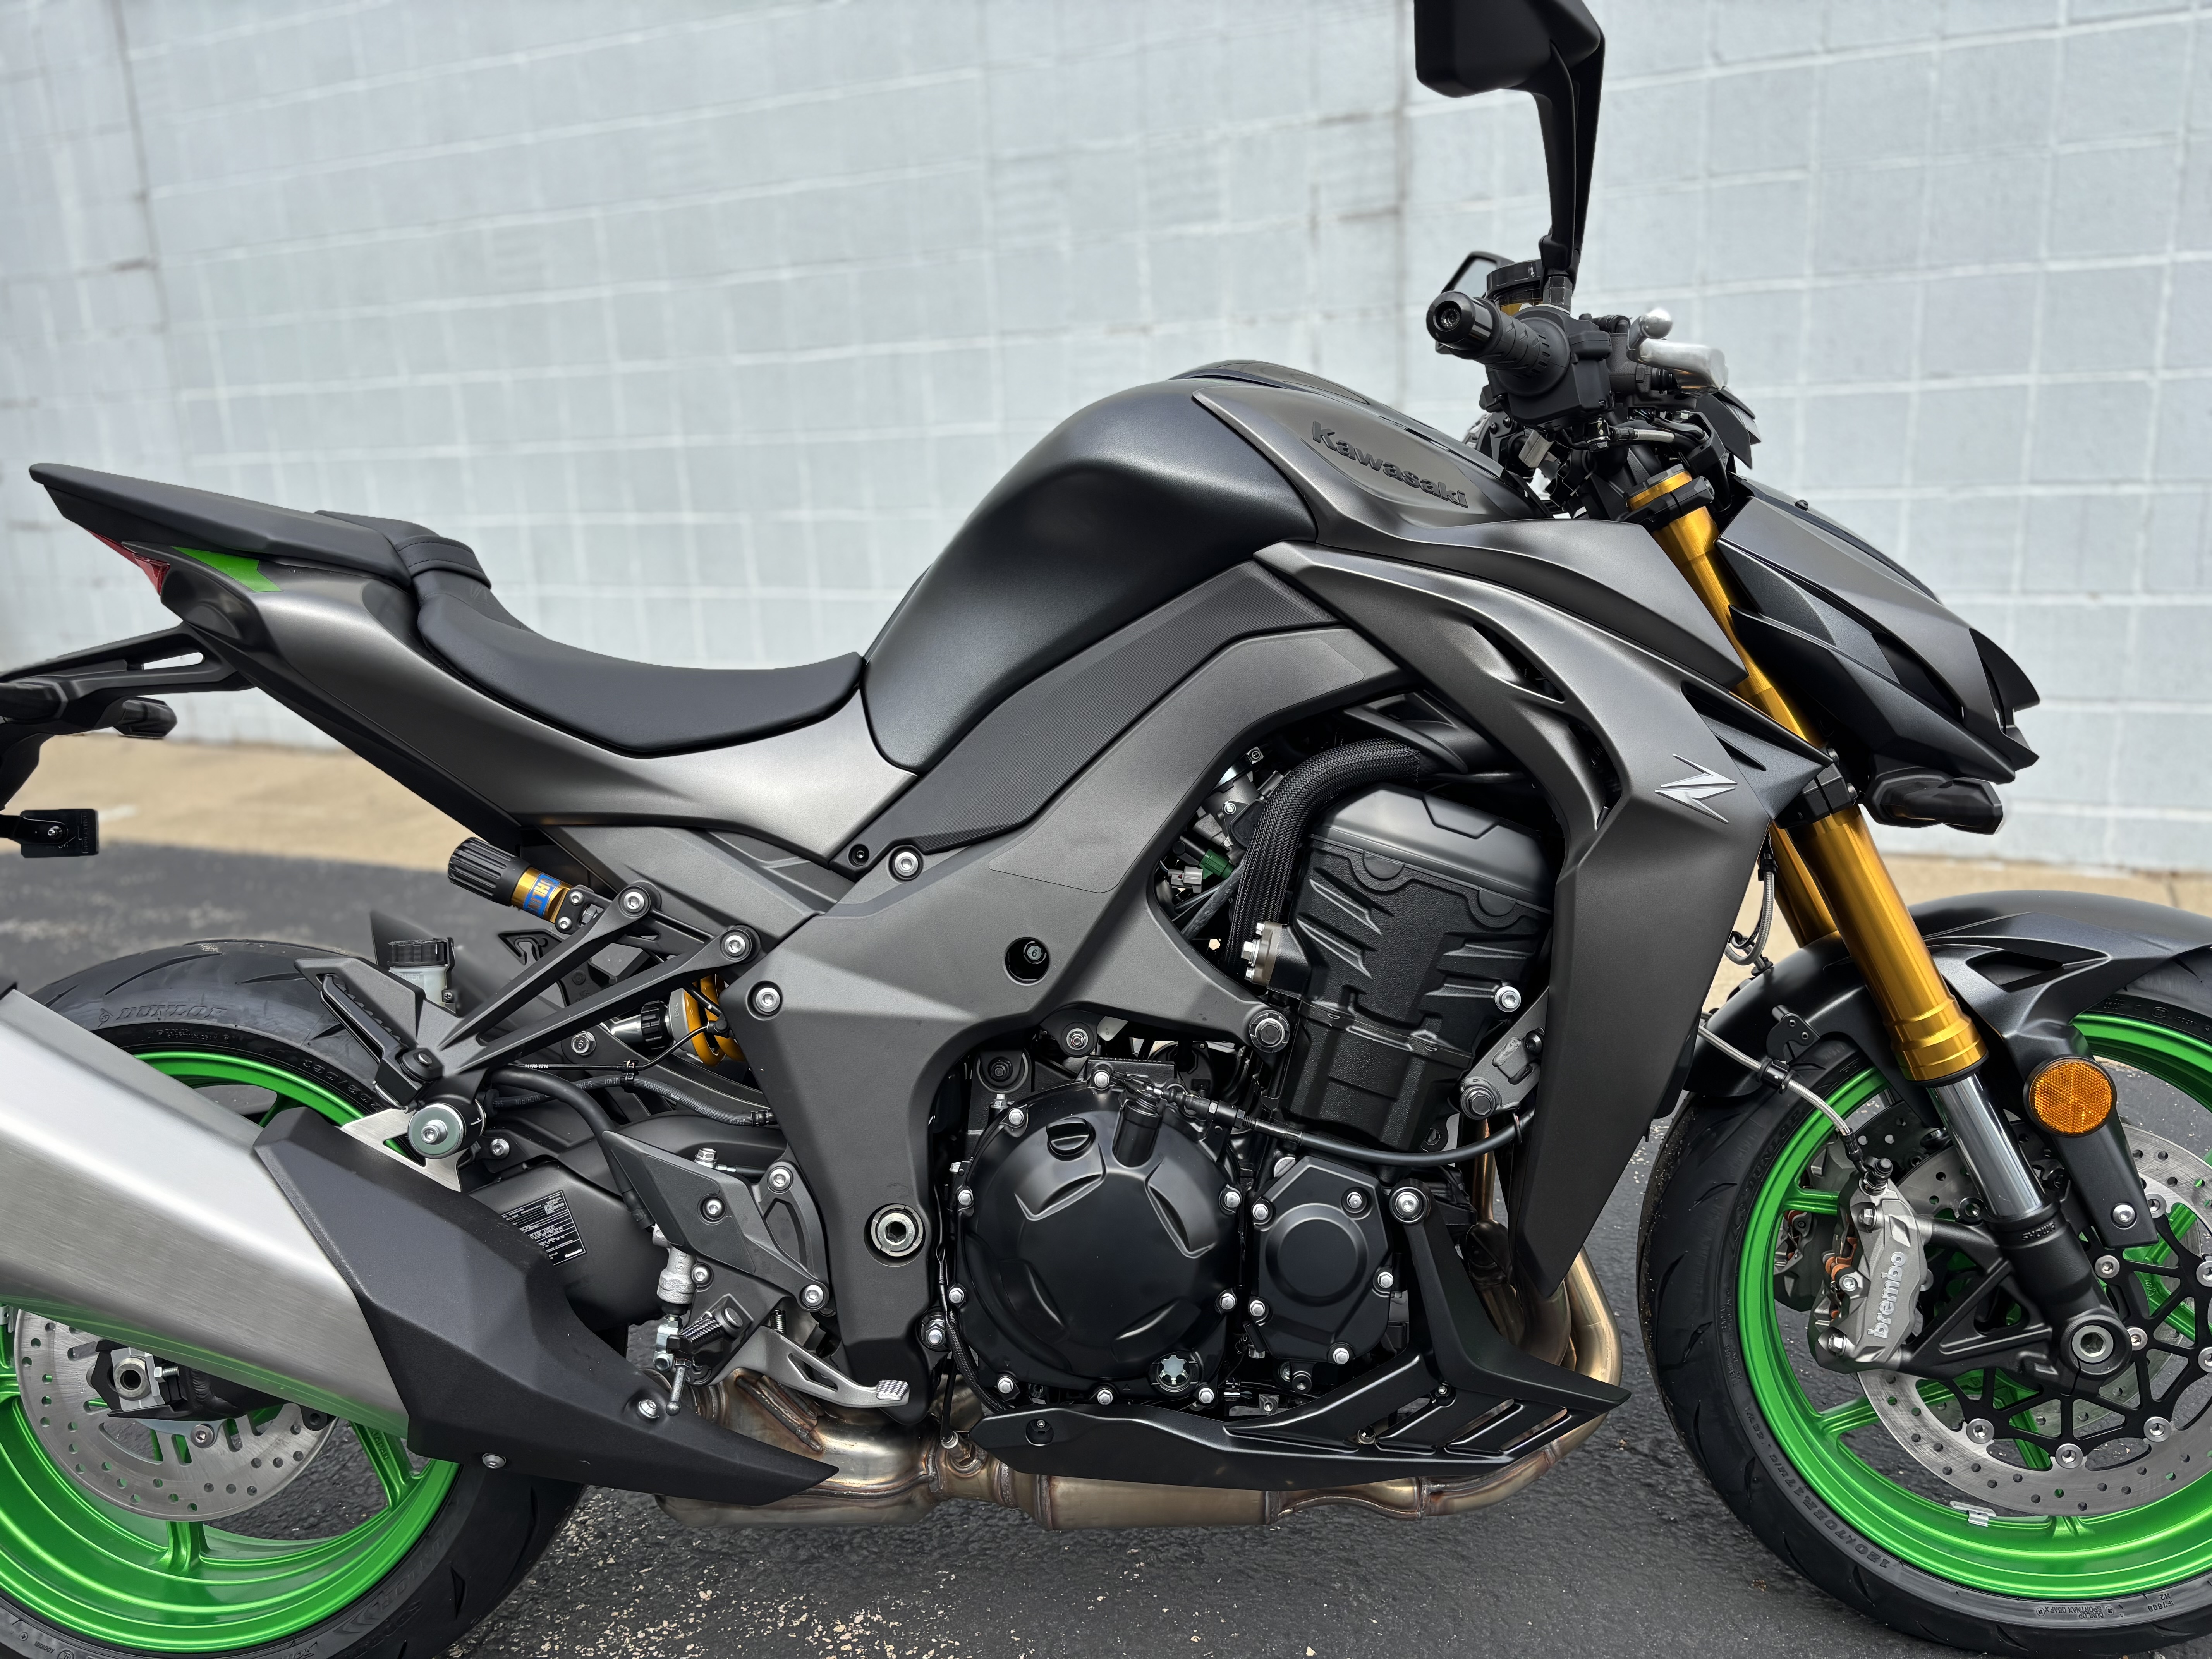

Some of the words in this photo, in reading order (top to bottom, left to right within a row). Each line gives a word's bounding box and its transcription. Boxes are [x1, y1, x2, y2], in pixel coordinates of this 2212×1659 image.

[1312, 421, 1468, 508] Kawasaki
[527, 878, 555, 911] ÖHLIN
[116, 1005, 227, 1020] DUNLOP
[1746, 1108, 1802, 1191] DUNLOP
[1867, 1252, 1906, 1339] brembo
[371, 1429, 390, 1460] JAPAN
[2068, 1606, 2101, 1614] SPORTMAX
